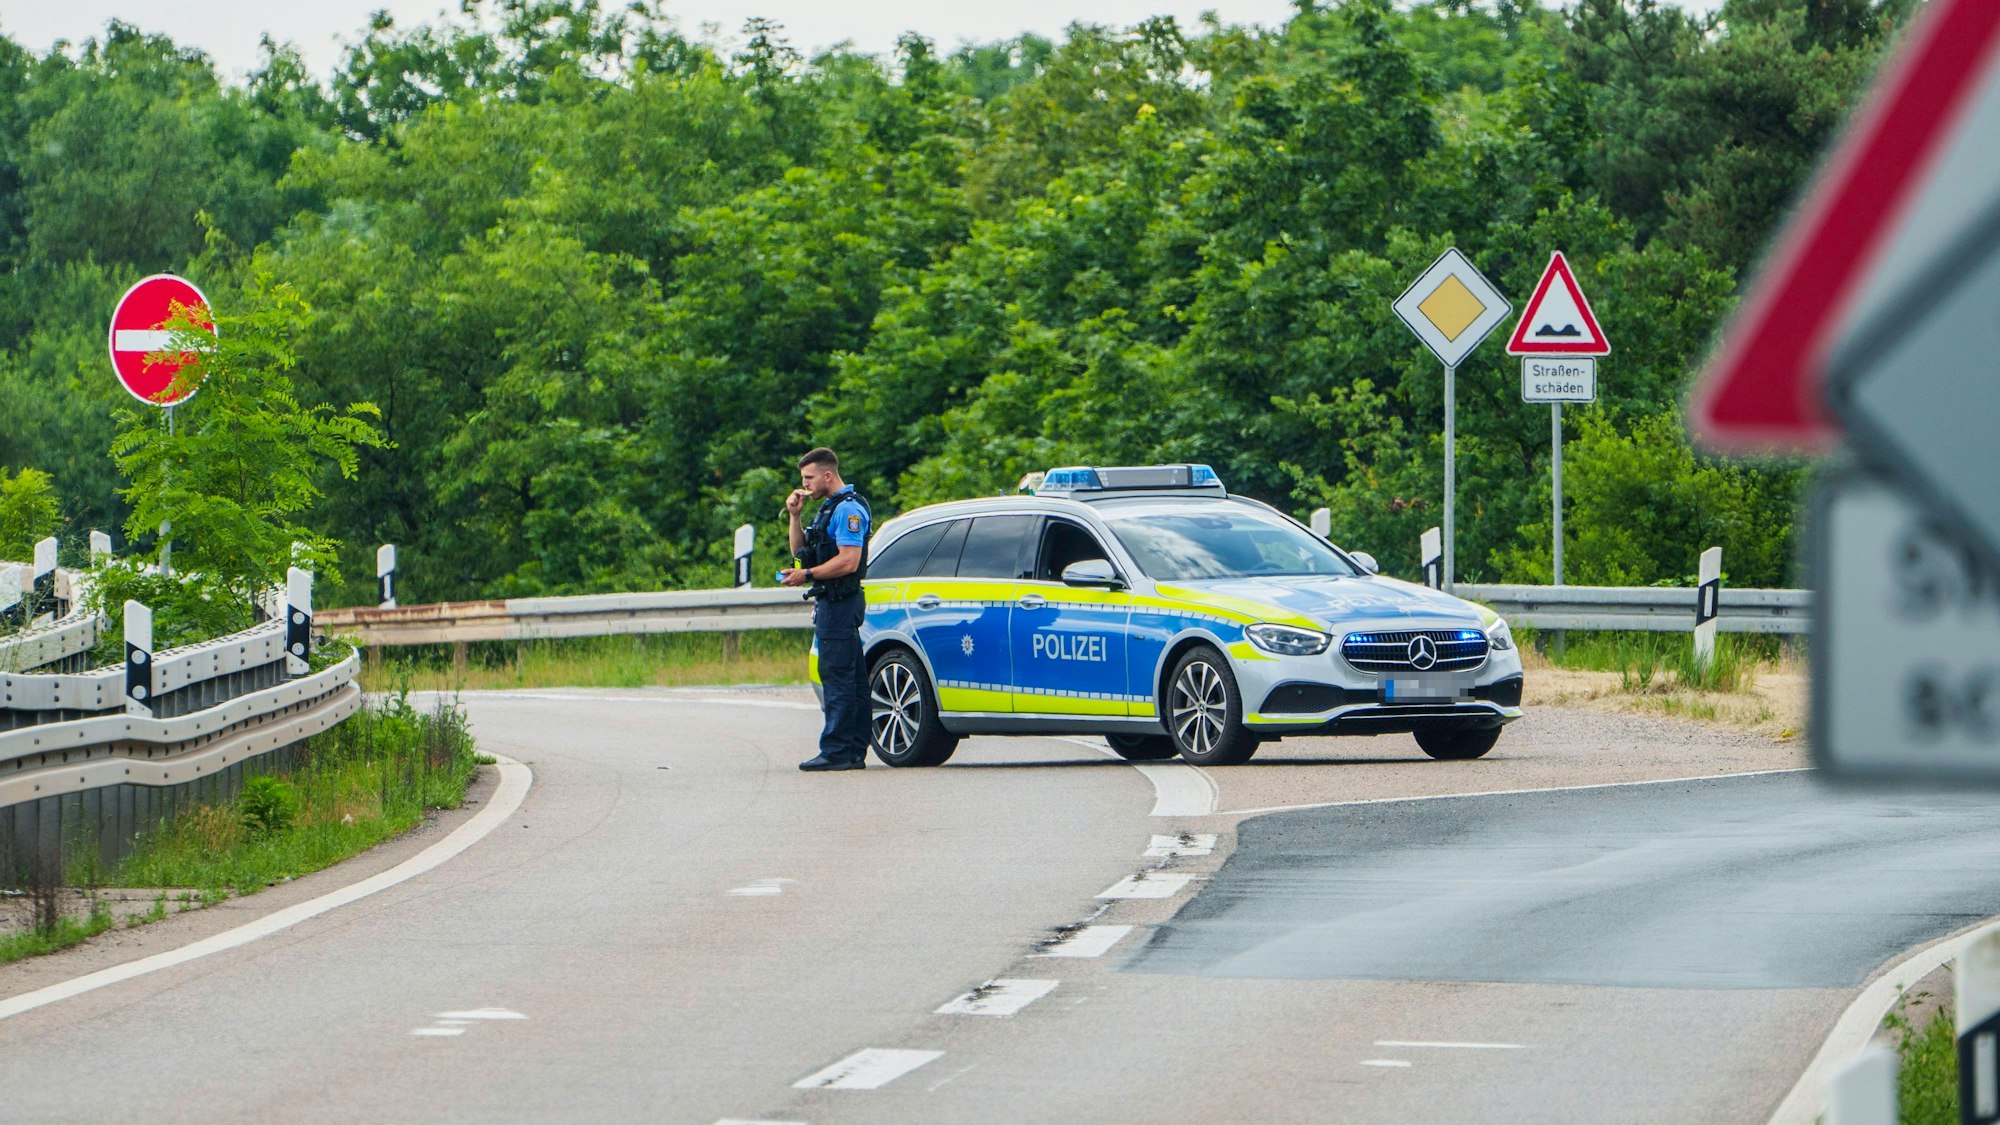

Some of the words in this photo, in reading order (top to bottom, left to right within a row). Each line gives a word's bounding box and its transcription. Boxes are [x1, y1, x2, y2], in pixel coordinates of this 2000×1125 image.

[1532, 364, 1586, 377] Straßen-
[1535, 381, 1584, 393] schäden
[1032, 633, 1107, 662] POLIZEI
